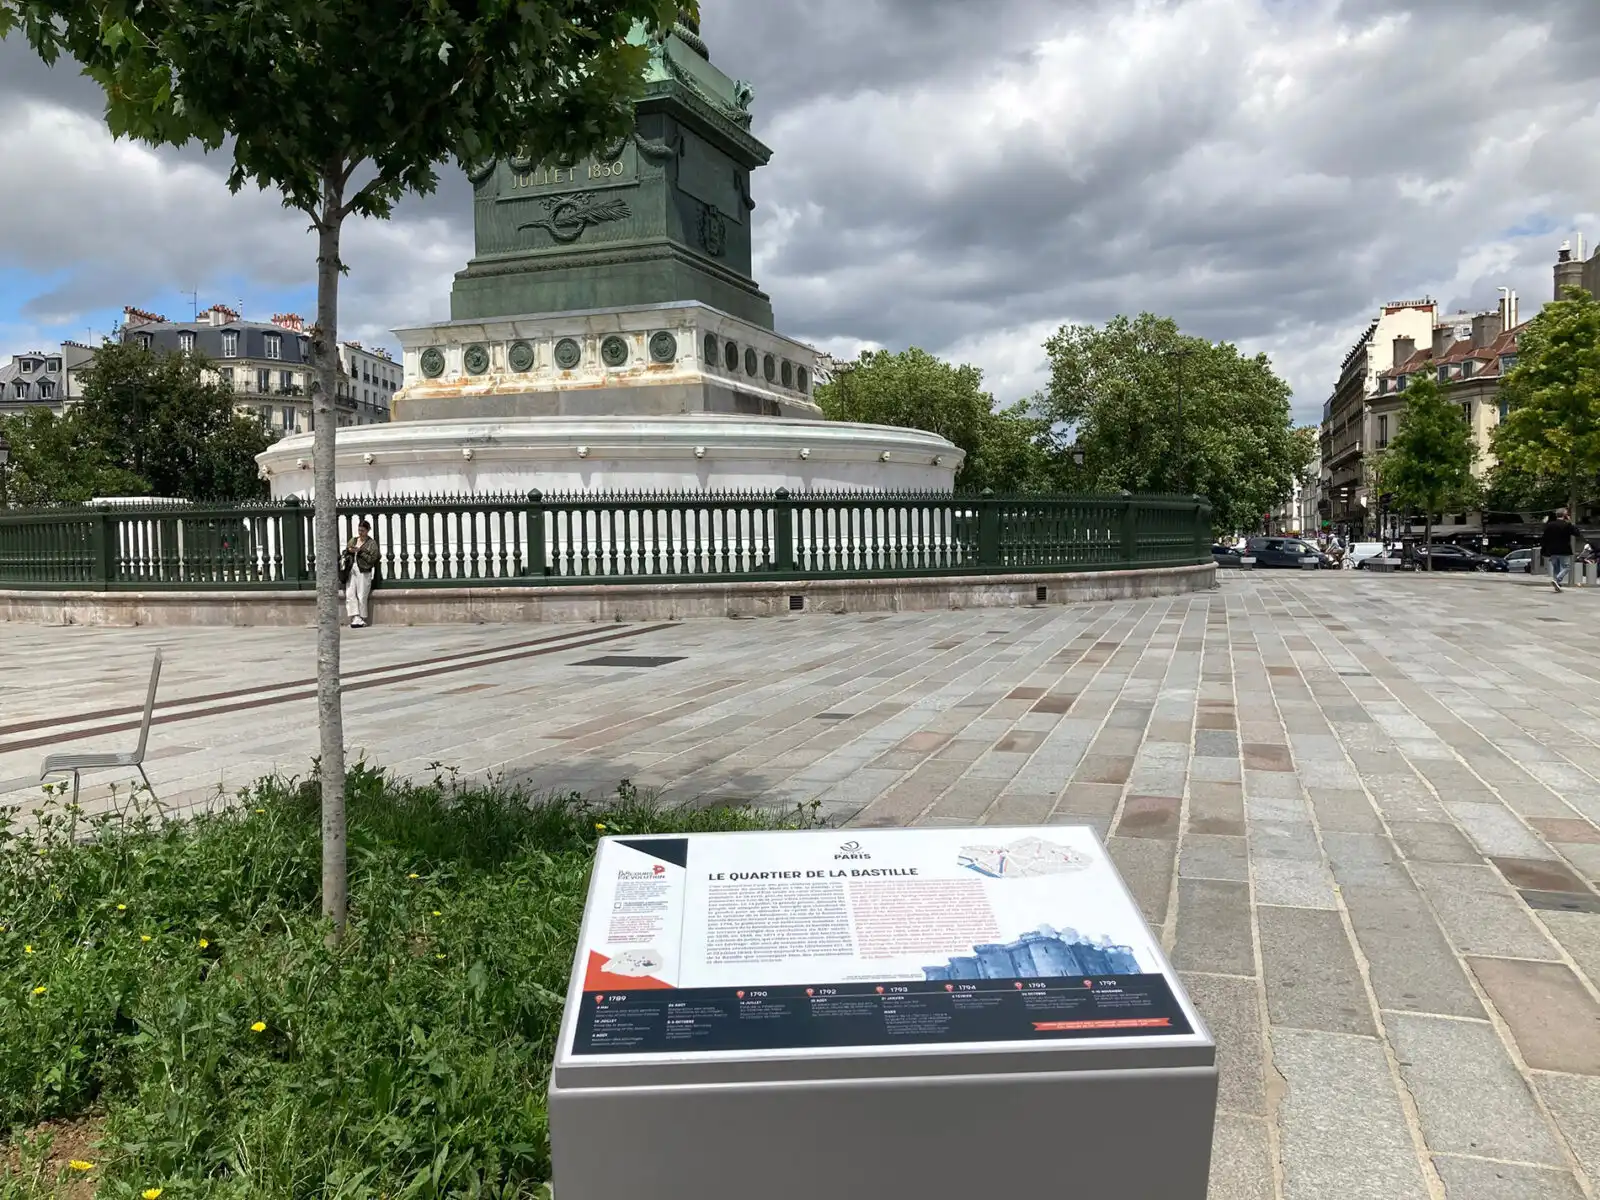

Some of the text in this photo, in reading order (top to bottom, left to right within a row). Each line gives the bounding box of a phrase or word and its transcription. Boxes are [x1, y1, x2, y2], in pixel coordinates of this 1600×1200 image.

[588, 161, 624, 180] 1830
[708, 868, 919, 881] LE QUARTIER DE LA BASTILLE
